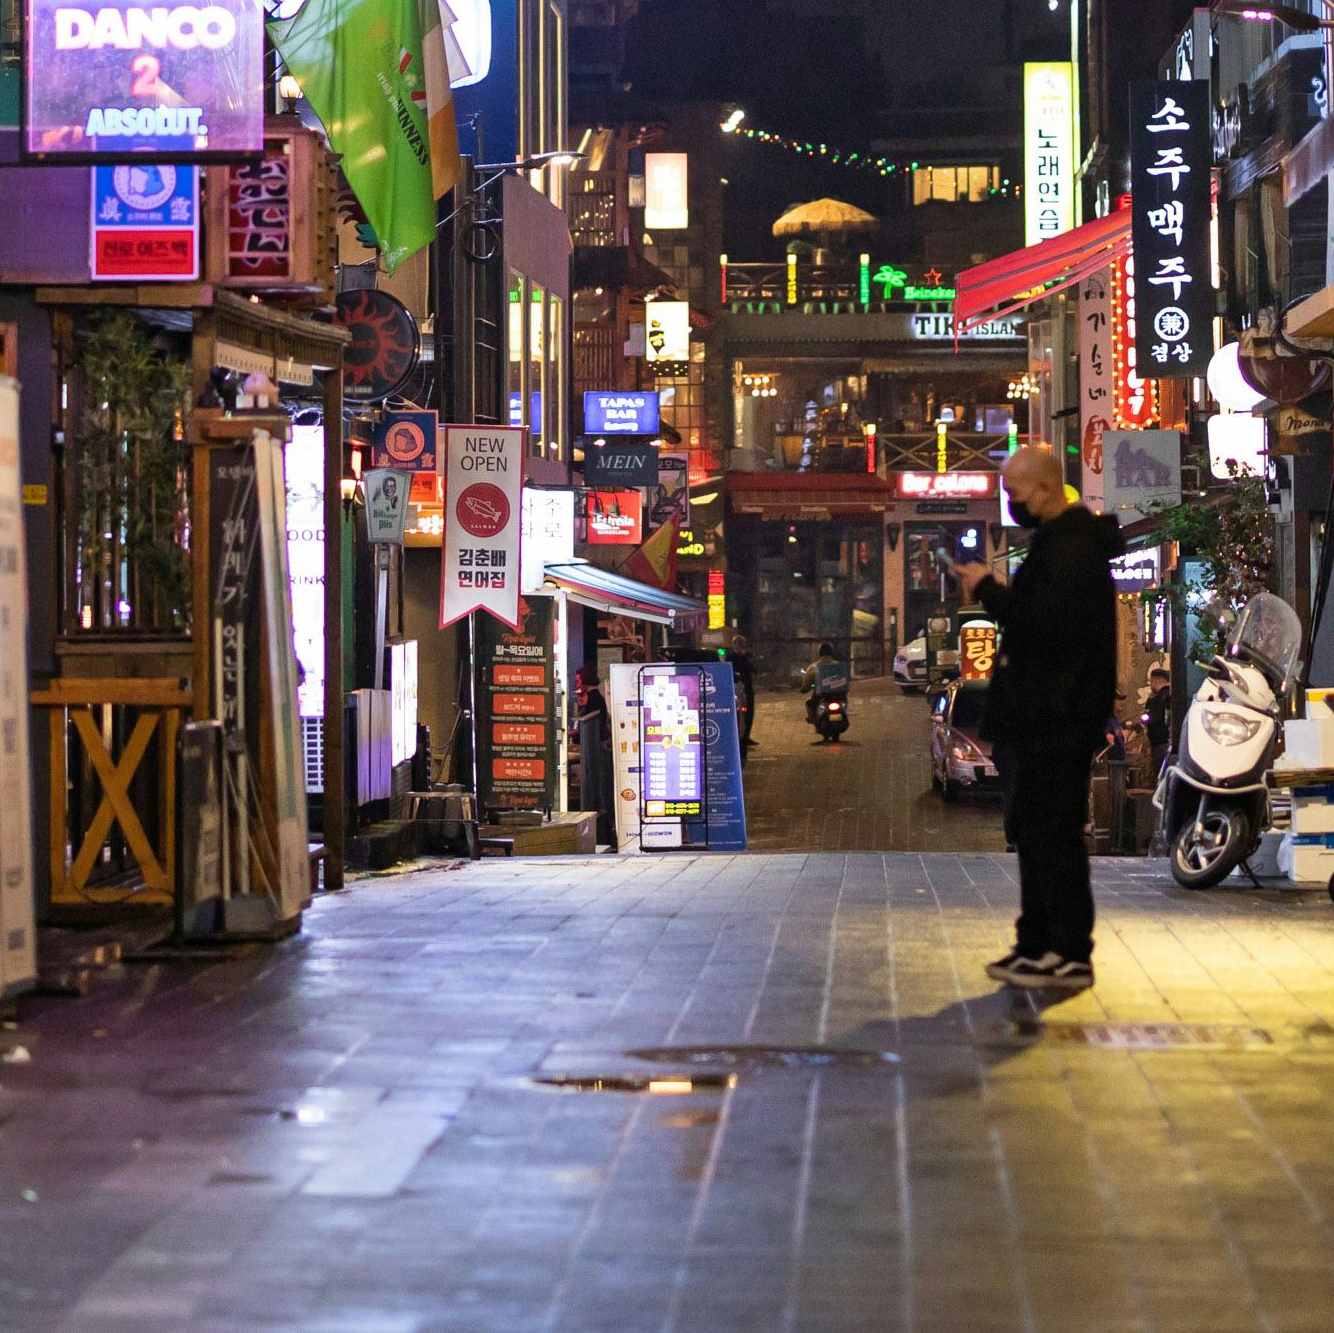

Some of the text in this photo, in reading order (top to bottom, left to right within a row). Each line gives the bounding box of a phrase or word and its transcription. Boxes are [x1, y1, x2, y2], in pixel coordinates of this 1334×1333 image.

[55, 6, 236, 50] DANCO
[130, 53, 161, 97] 2
[1038, 128, 1060, 243] 노래연습
[1145, 97, 1193, 301] 소주맥주
[914, 316, 1017, 336] TIK ISLA
[1149, 341, 1193, 364] 겸상
[598, 397, 645, 408] TAPAS
[605, 409, 638, 420] BAR
[465, 437, 505, 453] NEW
[460, 455, 508, 472] OPEN
[597, 454, 646, 470] MEIN
[287, 529, 325, 541] OOD
[458, 548, 507, 568] 김춘배
[290, 576, 326, 586] RINK
[458, 570, 506, 589] 연어집
[965, 639, 996, 672] 탕
